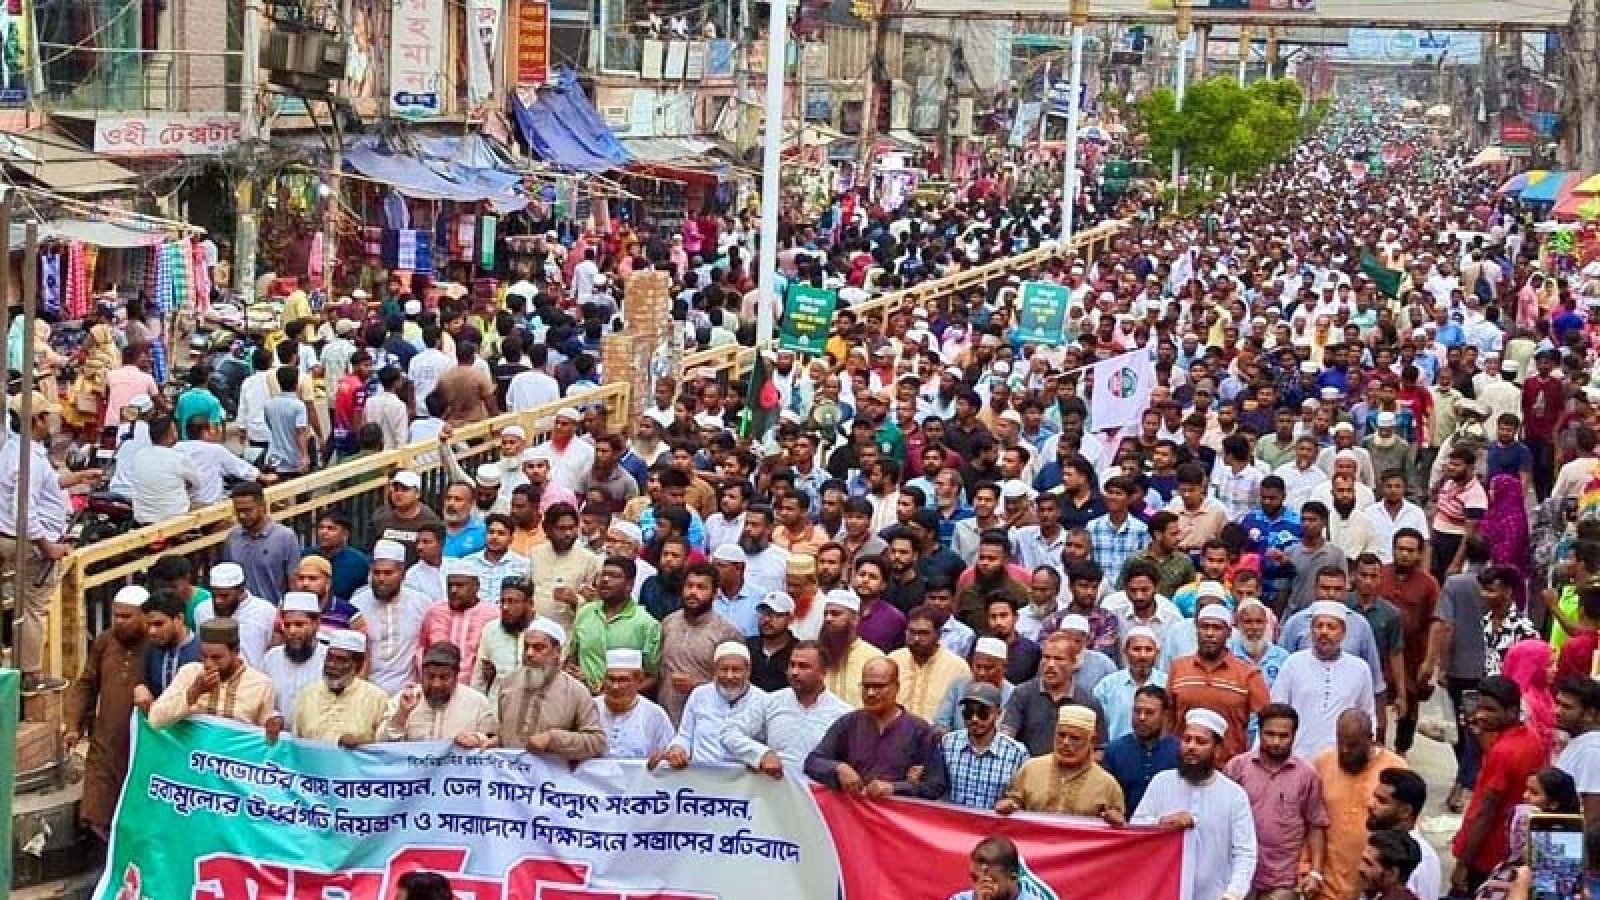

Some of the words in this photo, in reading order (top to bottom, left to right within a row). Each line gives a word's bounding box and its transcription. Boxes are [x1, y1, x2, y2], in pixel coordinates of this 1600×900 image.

[102, 121, 145, 145] ওহী
[191, 752, 295, 790] গণভোটের
[444, 777, 481, 797] তেল
[488, 781, 535, 804] গ্যাস
[540, 781, 599, 819] বিদ্যুৎ
[606, 790, 670, 815] সংকট
[676, 788, 752, 820] নিরসন,
[334, 808, 409, 836] নিয়ন্ত্রণ
[414, 812, 431, 831] ও
[438, 813, 527, 839] সারাদেশে
[532, 816, 627, 852] শিক্ষাঙ্গনে
[632, 831, 715, 854] সন্ত্রাসের
[718, 828, 800, 862] প্রতিবাদে
